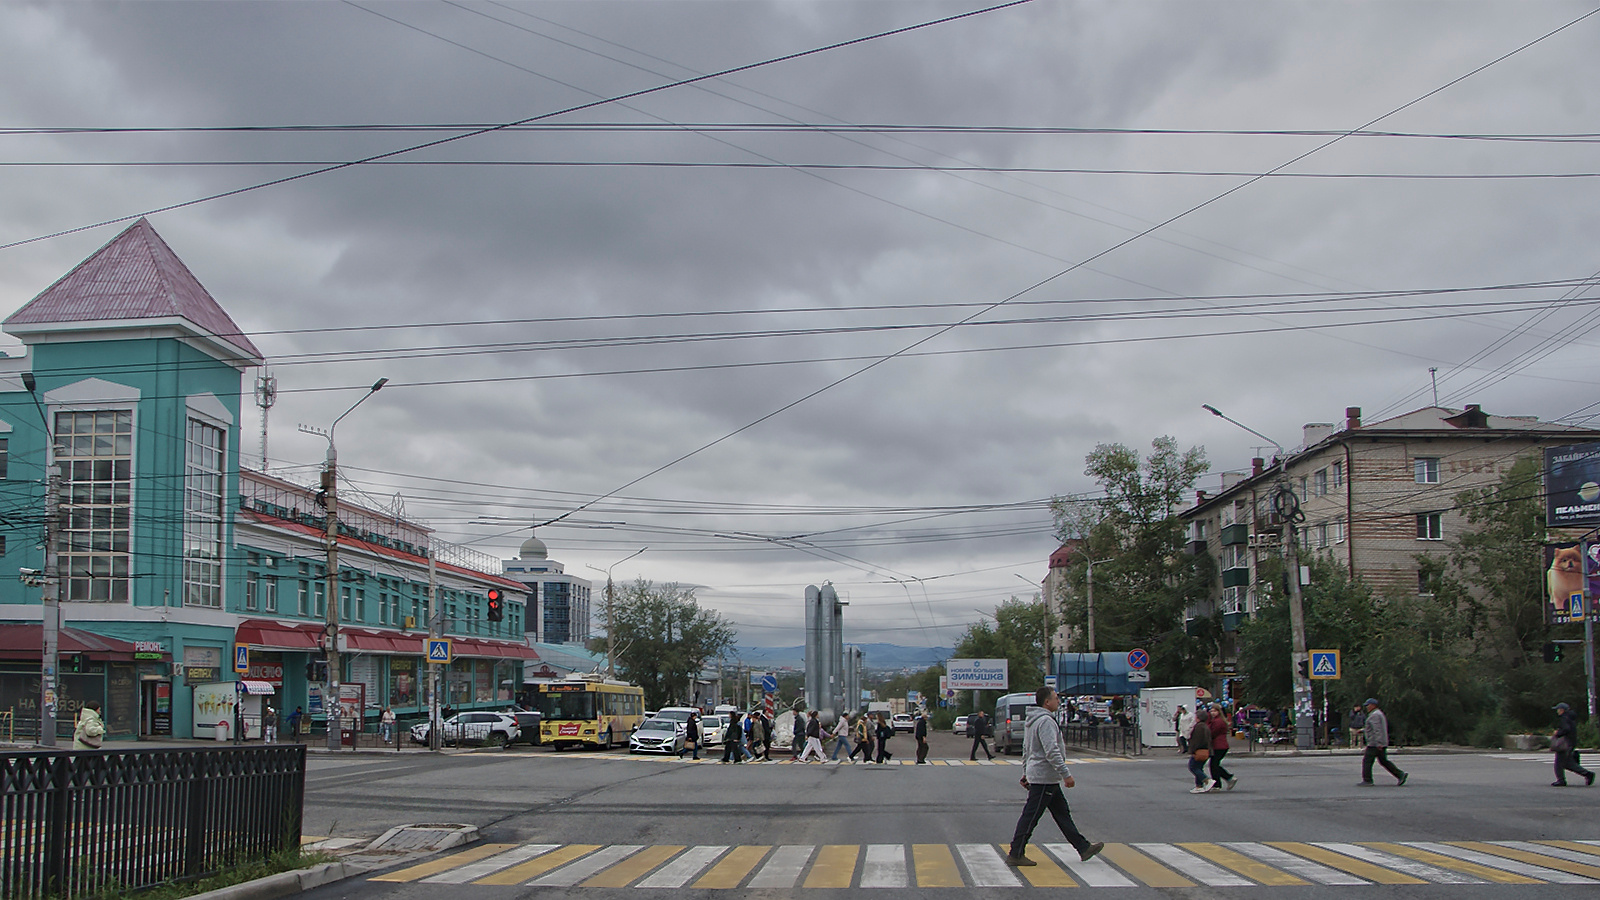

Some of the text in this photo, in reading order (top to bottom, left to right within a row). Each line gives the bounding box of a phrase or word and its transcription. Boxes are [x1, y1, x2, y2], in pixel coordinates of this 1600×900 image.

[135, 641, 162, 651] РЕМОНТ
[188, 668, 213, 678] REMAX
[19, 698, 36, 709] НА
